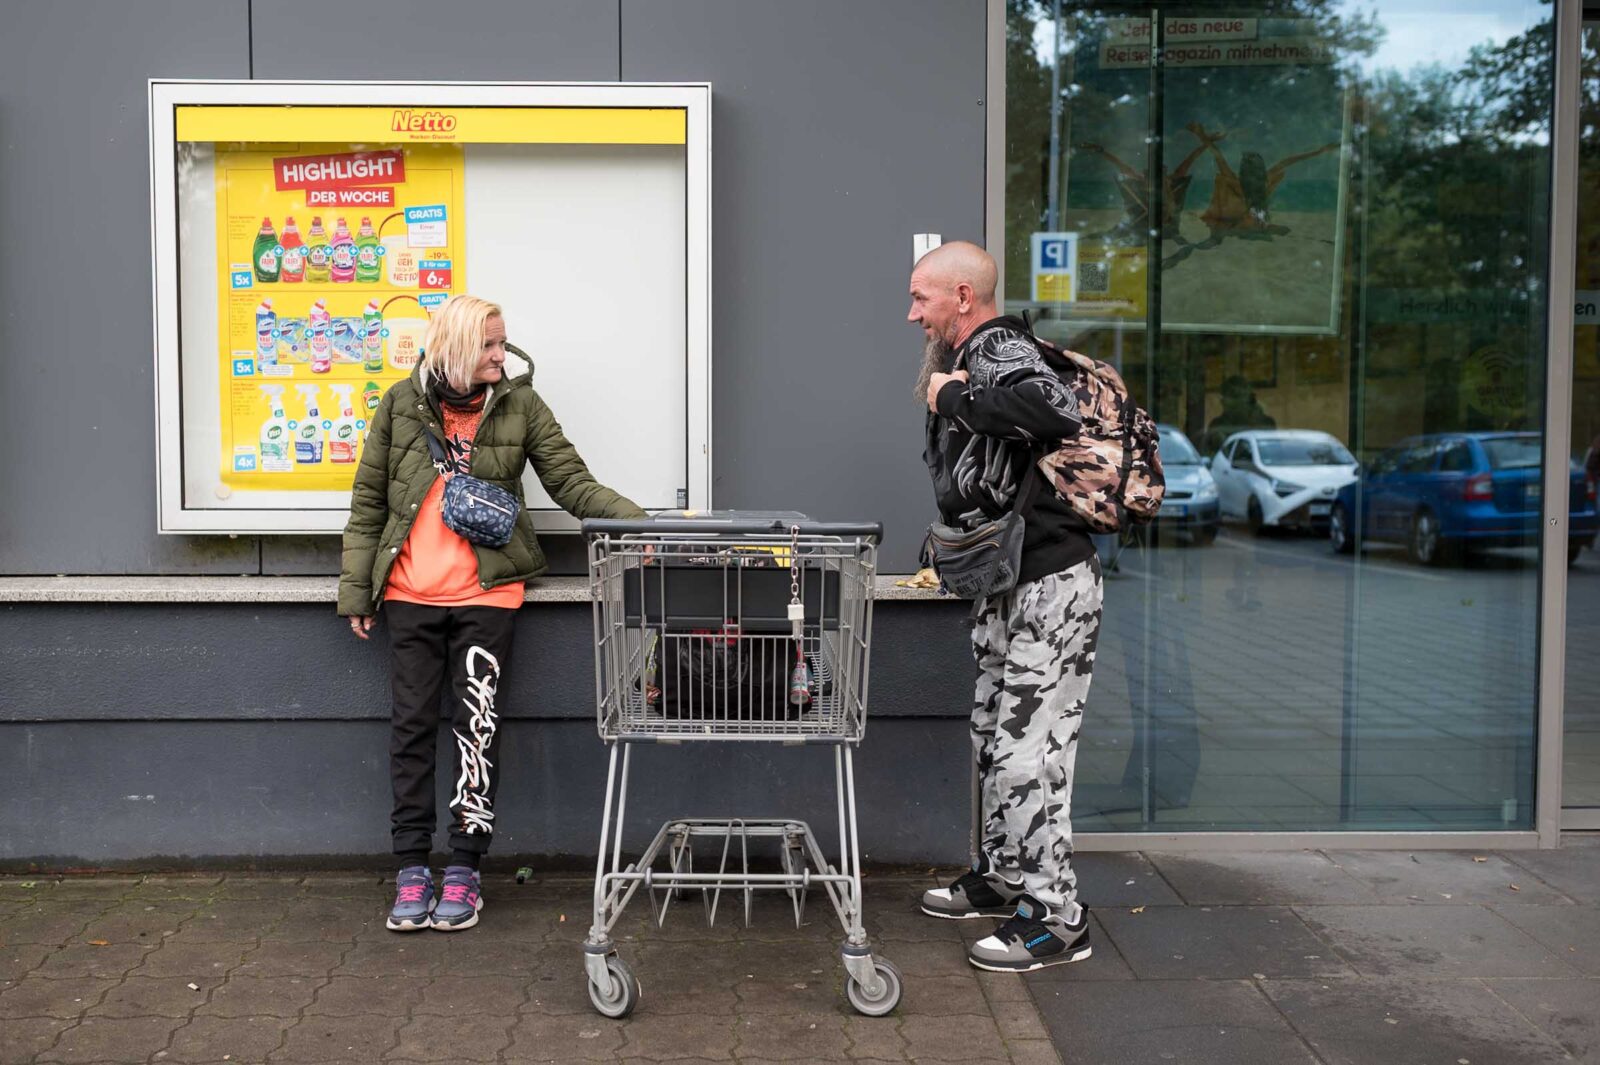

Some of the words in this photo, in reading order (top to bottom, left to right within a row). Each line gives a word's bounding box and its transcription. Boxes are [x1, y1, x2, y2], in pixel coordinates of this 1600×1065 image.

[1166, 20, 1197, 35] das
[1203, 20, 1244, 33] neue
[1106, 45, 1221, 64] Reiseagazin
[391, 110, 457, 131] Netto
[282, 157, 396, 183] HIGHLIGHT
[311, 191, 337, 203] DER
[339, 191, 390, 203] WOCHE
[408, 208, 443, 220] GRATIS
[234, 274, 250, 286] 5x
[236, 362, 252, 374] 5x
[237, 457, 254, 468] 4x
